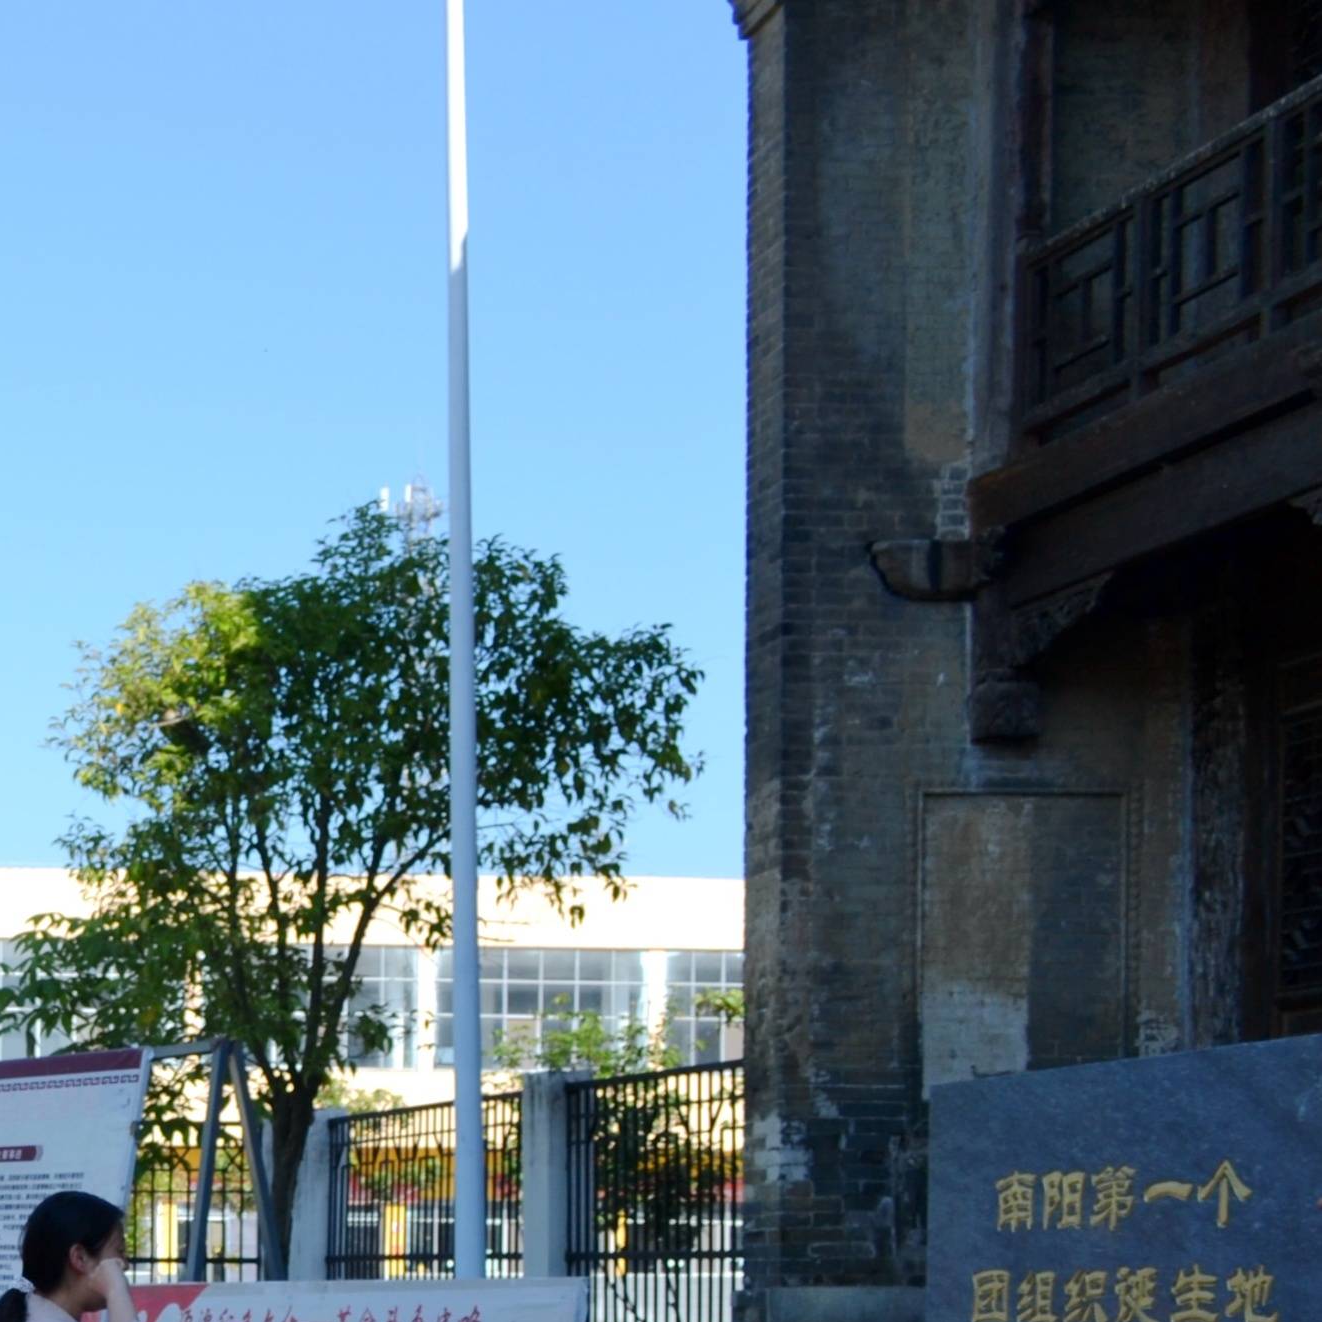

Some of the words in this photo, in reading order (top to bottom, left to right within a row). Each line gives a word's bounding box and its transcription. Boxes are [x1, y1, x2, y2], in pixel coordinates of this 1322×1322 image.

[993, 1158, 1254, 1233] 南阳第一个
